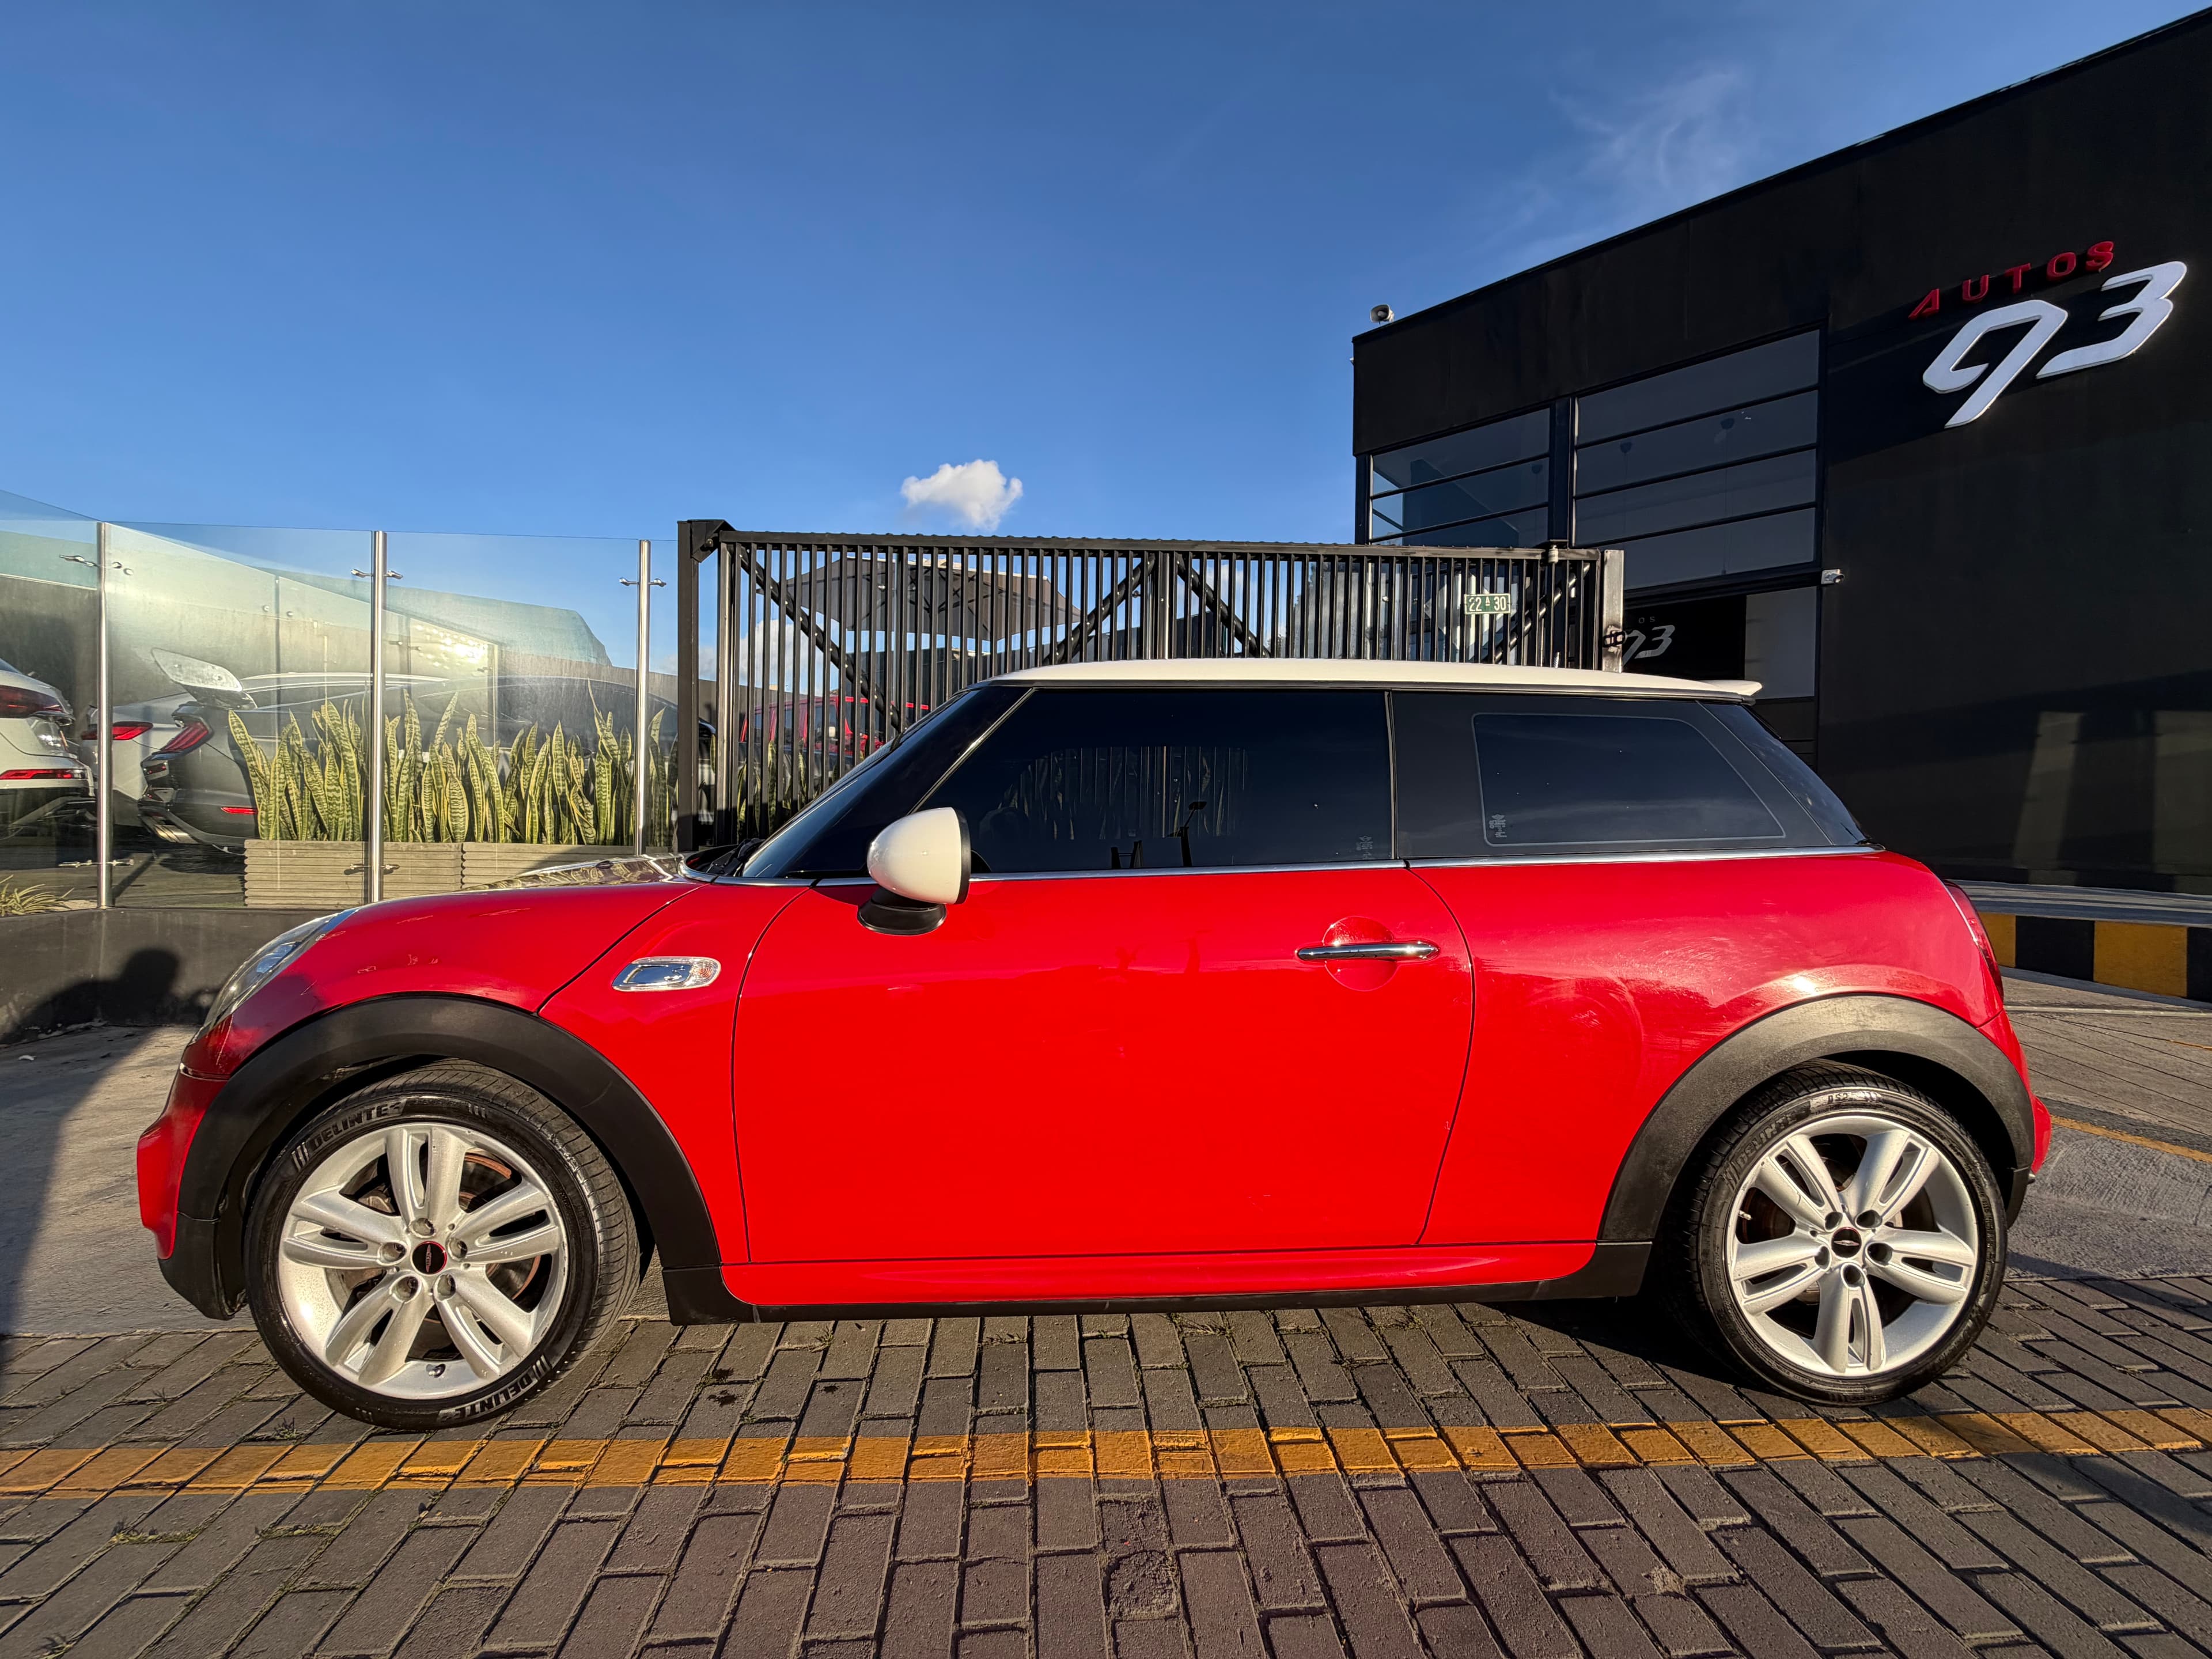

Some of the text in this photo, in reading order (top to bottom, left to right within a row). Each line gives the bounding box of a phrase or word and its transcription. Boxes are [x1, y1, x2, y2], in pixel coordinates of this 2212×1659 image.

[1908, 241, 2114, 320] AUTOS
[1922, 260, 2187, 429] 93
[1468, 597, 1482, 612] 22
[1494, 596, 1506, 611] 30
[310, 1104, 389, 1149] DELINTE
[454, 1372, 533, 1418] DELINTE
